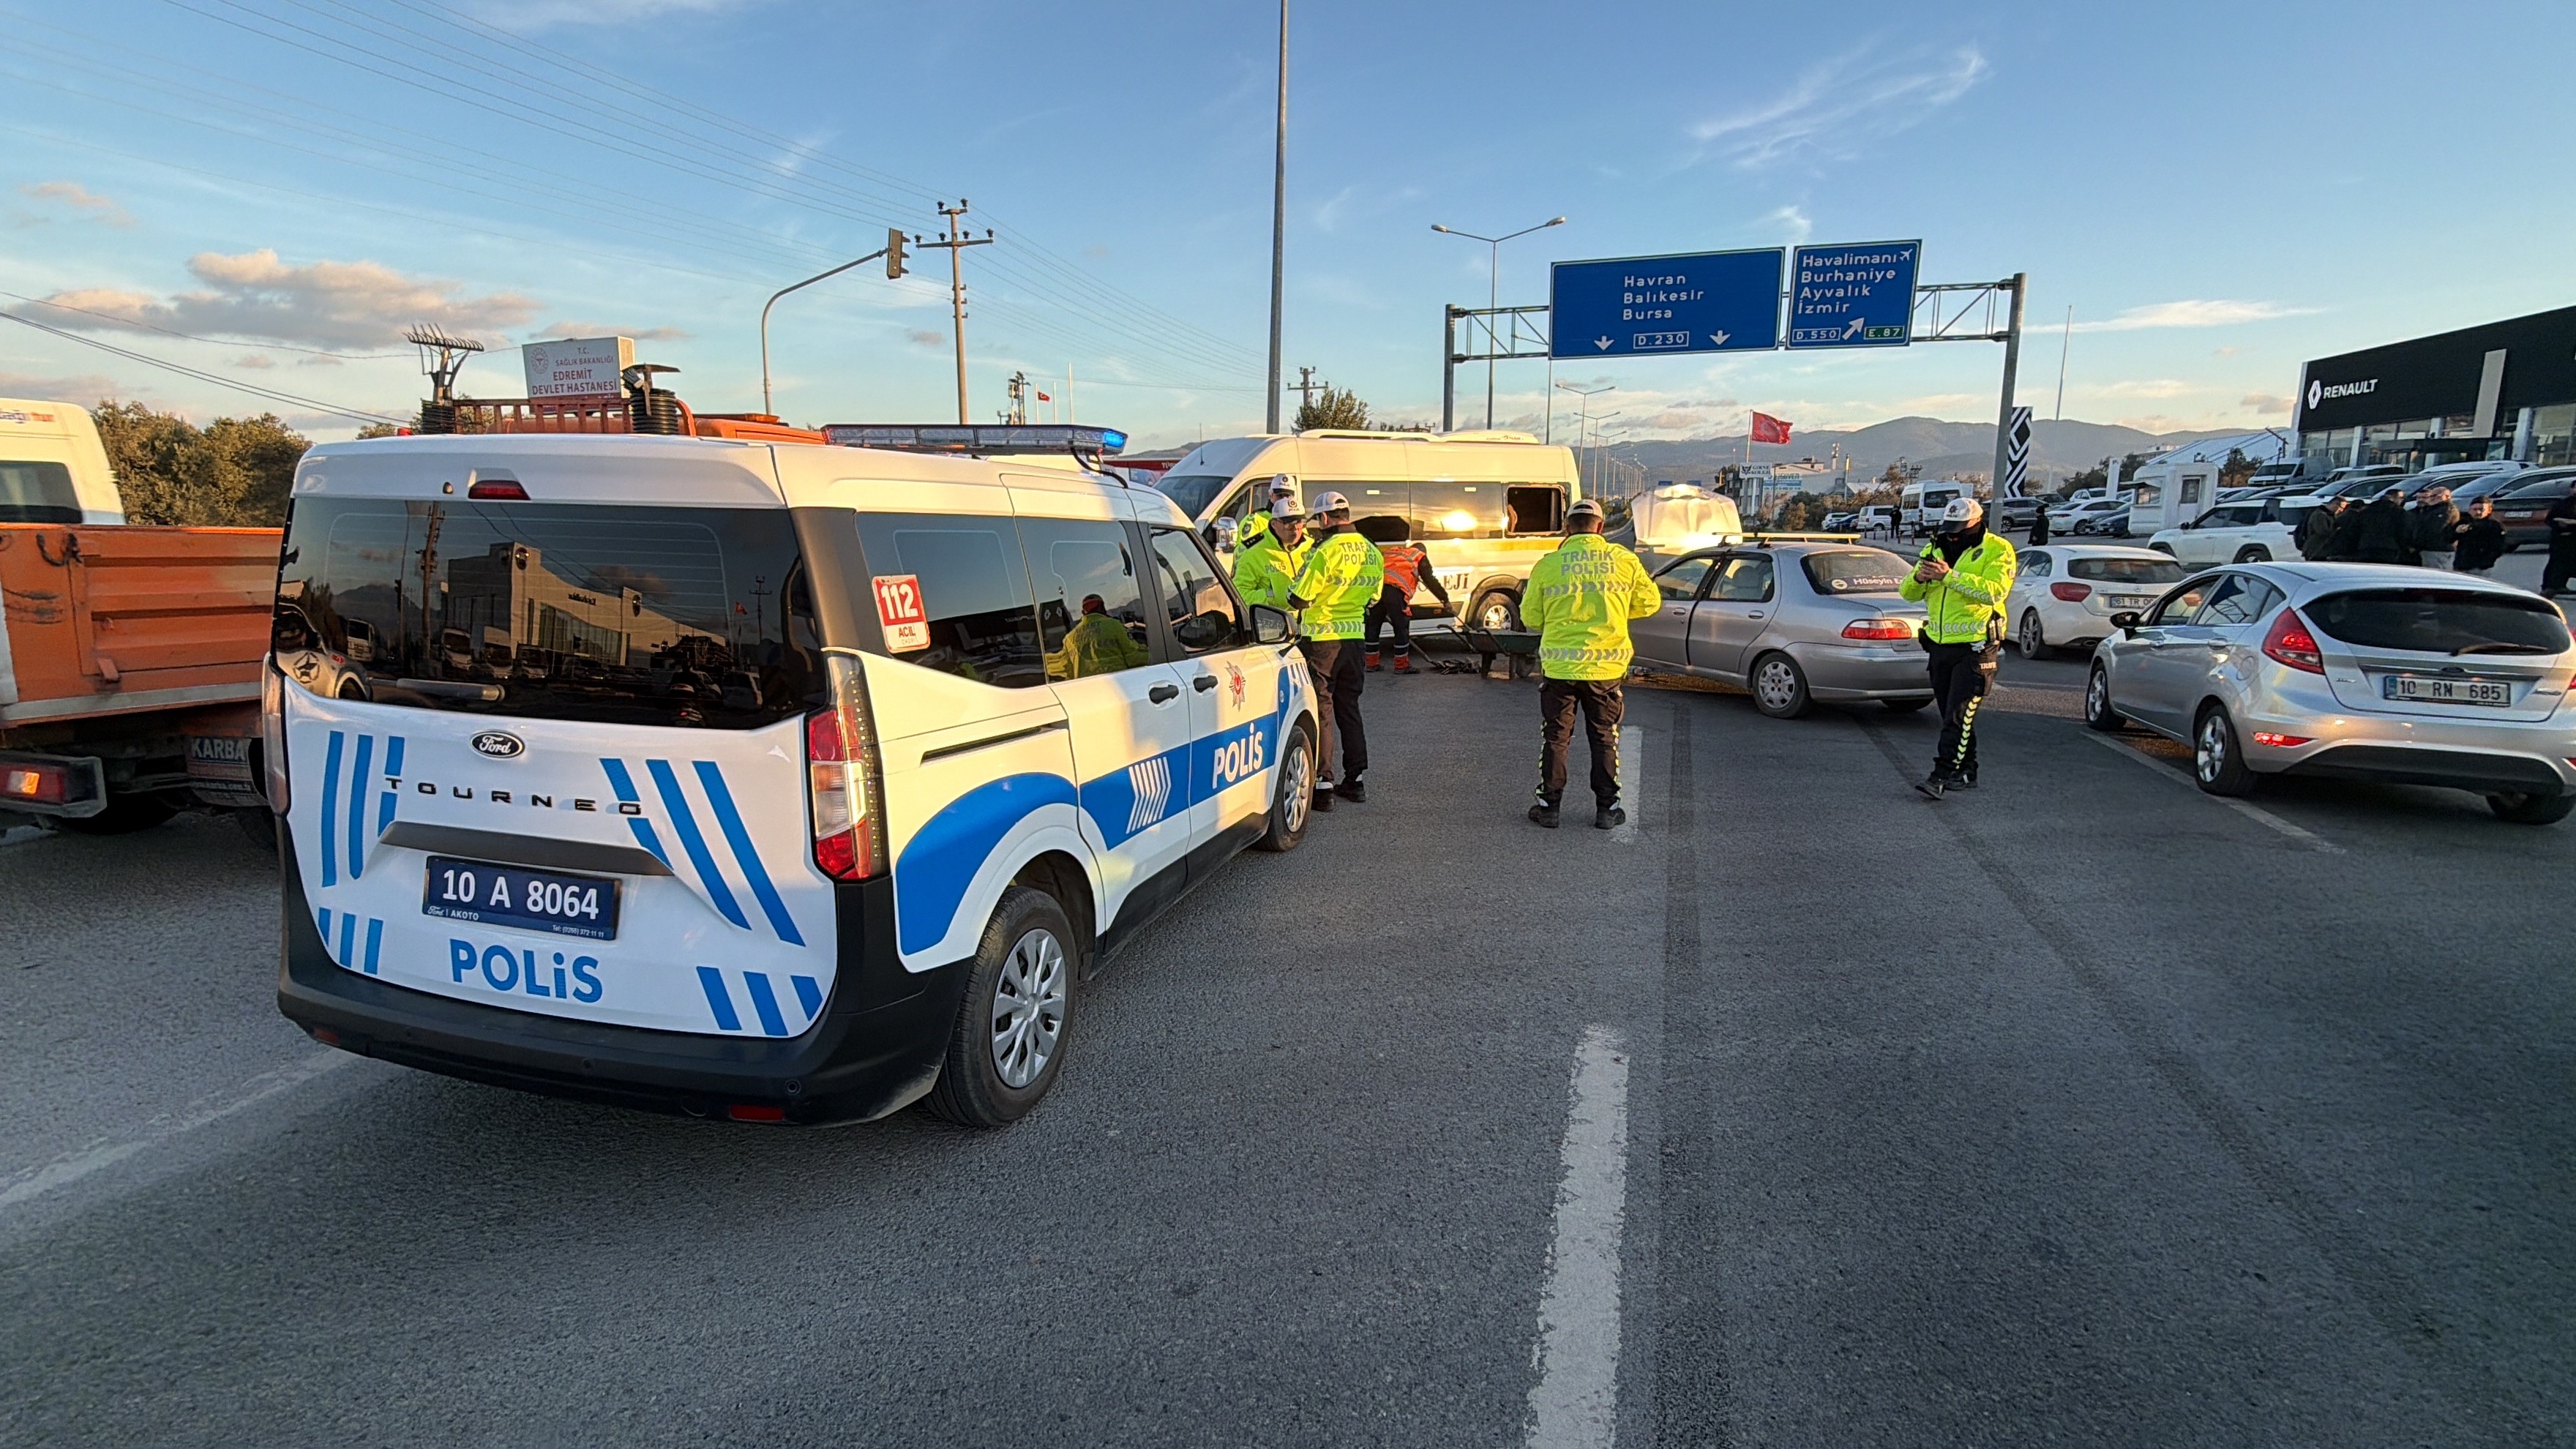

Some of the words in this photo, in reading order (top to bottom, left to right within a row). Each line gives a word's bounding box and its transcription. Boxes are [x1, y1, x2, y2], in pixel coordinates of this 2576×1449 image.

[1802, 252, 1897, 267] Havalimanı
[1624, 275, 1686, 288] Havran
[1801, 268, 1896, 283] Burhaniye
[1623, 289, 1704, 304] Balıkesir
[1800, 284, 1871, 301] Ayvalık
[1622, 308, 1672, 321] Bursa
[1797, 299, 1850, 315] İzmir
[1638, 334, 1685, 345] D.230
[1796, 329, 1837, 340] D.550
[1868, 328, 1901, 337] E.87
[555, 358, 577, 367] SAĞLIK
[579, 354, 613, 364] BAKANLIĞI
[553, 367, 593, 381] EDREMİT
[532, 383, 566, 395] DEVLET
[567, 378, 618, 393] HASTANESİ
[2323, 378, 2378, 400] RENAULT
[1561, 550, 1614, 564] TRAFİK
[1560, 561, 1615, 577] POLİSİ
[1853, 577, 1893, 585] Hüseyin
[880, 583, 919, 620] 112
[2400, 680, 2416, 694] 10
[2433, 682, 2452, 697] RN
[2469, 684, 2501, 700] 685
[479, 734, 512, 755] Ford
[385, 776, 642, 816] TOURNEO
[443, 869, 476, 903] 10
[489, 876, 512, 908] A
[526, 880, 599, 920] 8064
[450, 910, 479, 921] AKOTO
